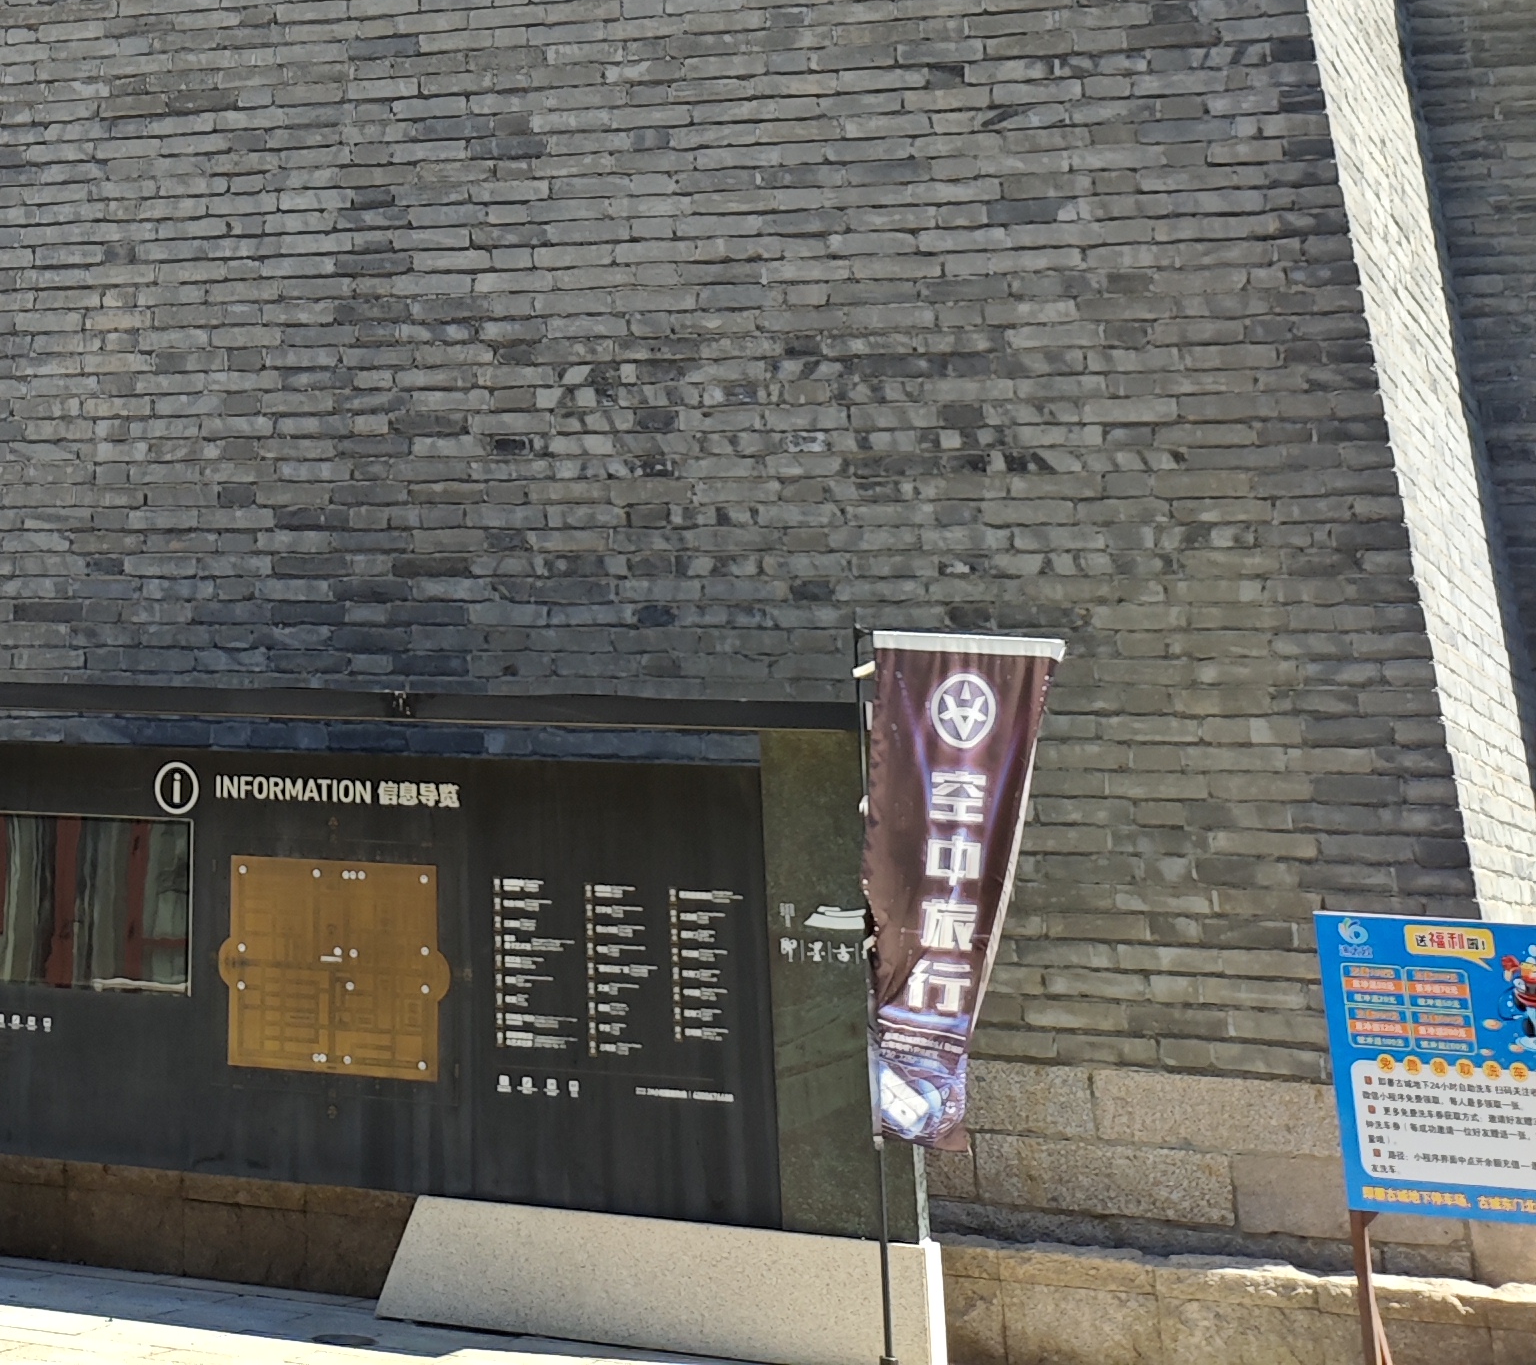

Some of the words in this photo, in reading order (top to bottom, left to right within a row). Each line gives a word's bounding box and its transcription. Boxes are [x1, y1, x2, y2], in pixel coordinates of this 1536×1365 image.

[214, 774, 372, 804] INFORMATION
[376, 780, 461, 808] 信息导览
[906, 769, 988, 1012] 空中旅行
